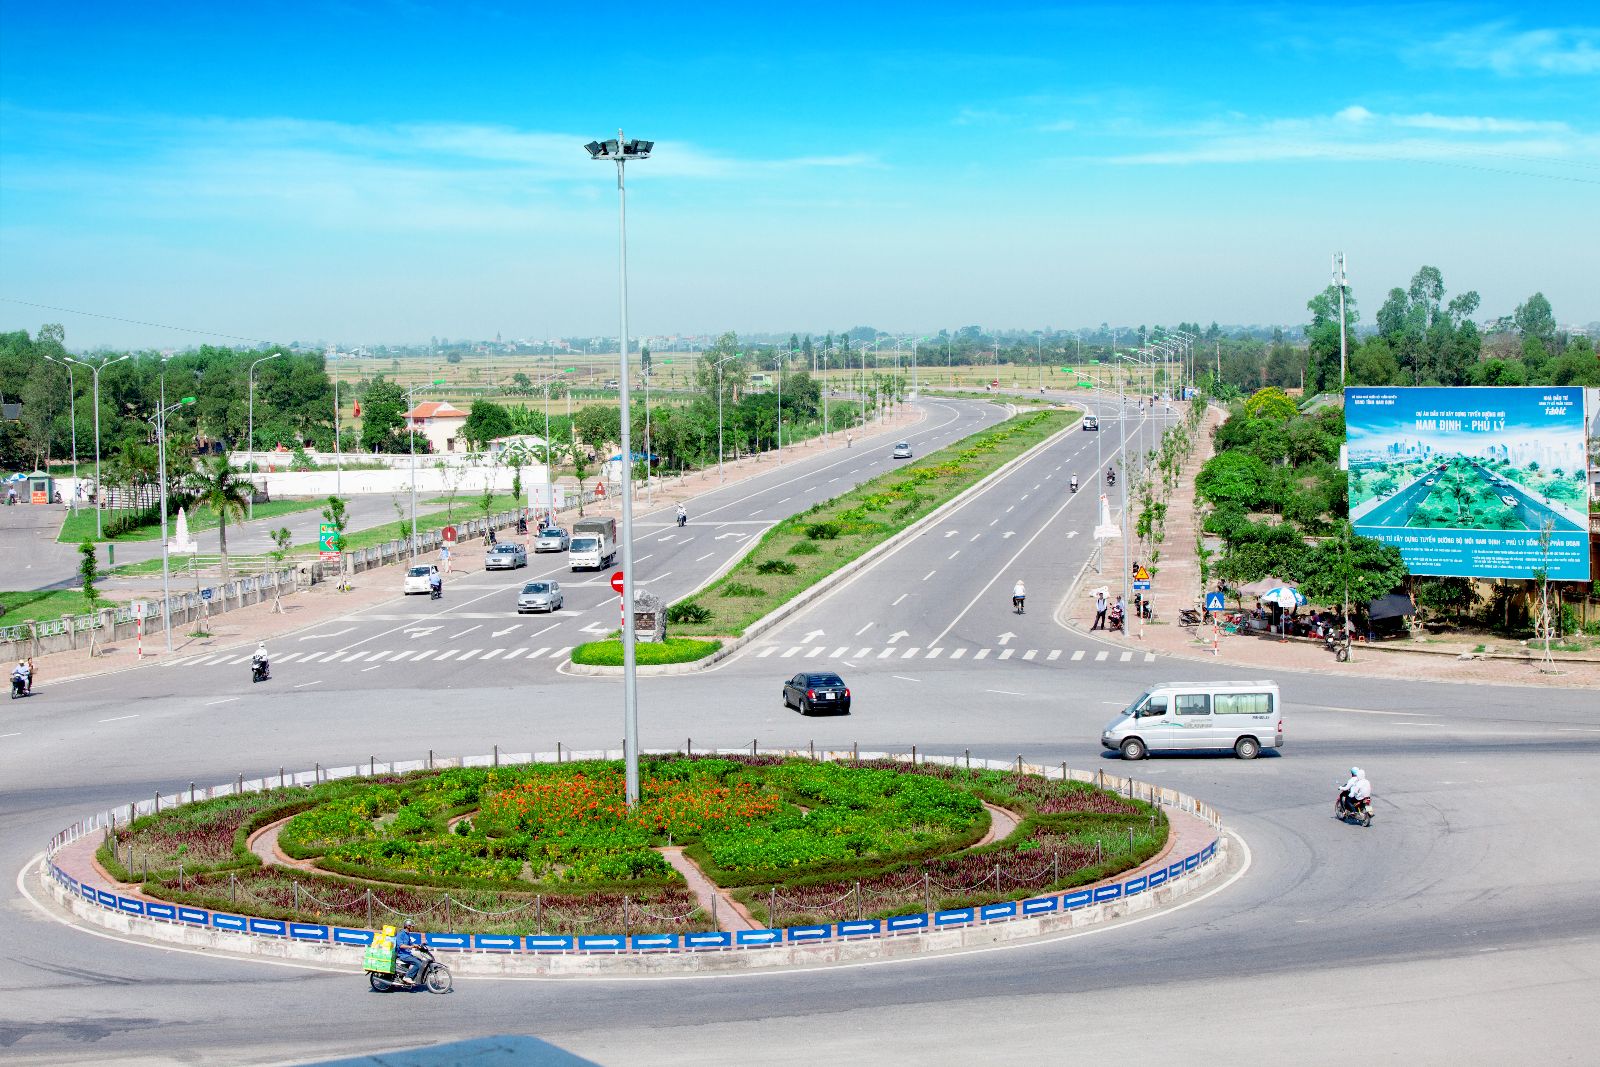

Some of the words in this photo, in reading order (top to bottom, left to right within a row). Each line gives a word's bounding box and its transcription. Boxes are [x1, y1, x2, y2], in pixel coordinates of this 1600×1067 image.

[1416, 420, 1436, 430] NAM
[1439, 420, 1461, 432] ĐỊNH
[1472, 417, 1490, 431] PHỦ
[1494, 418, 1505, 431] LÝ
